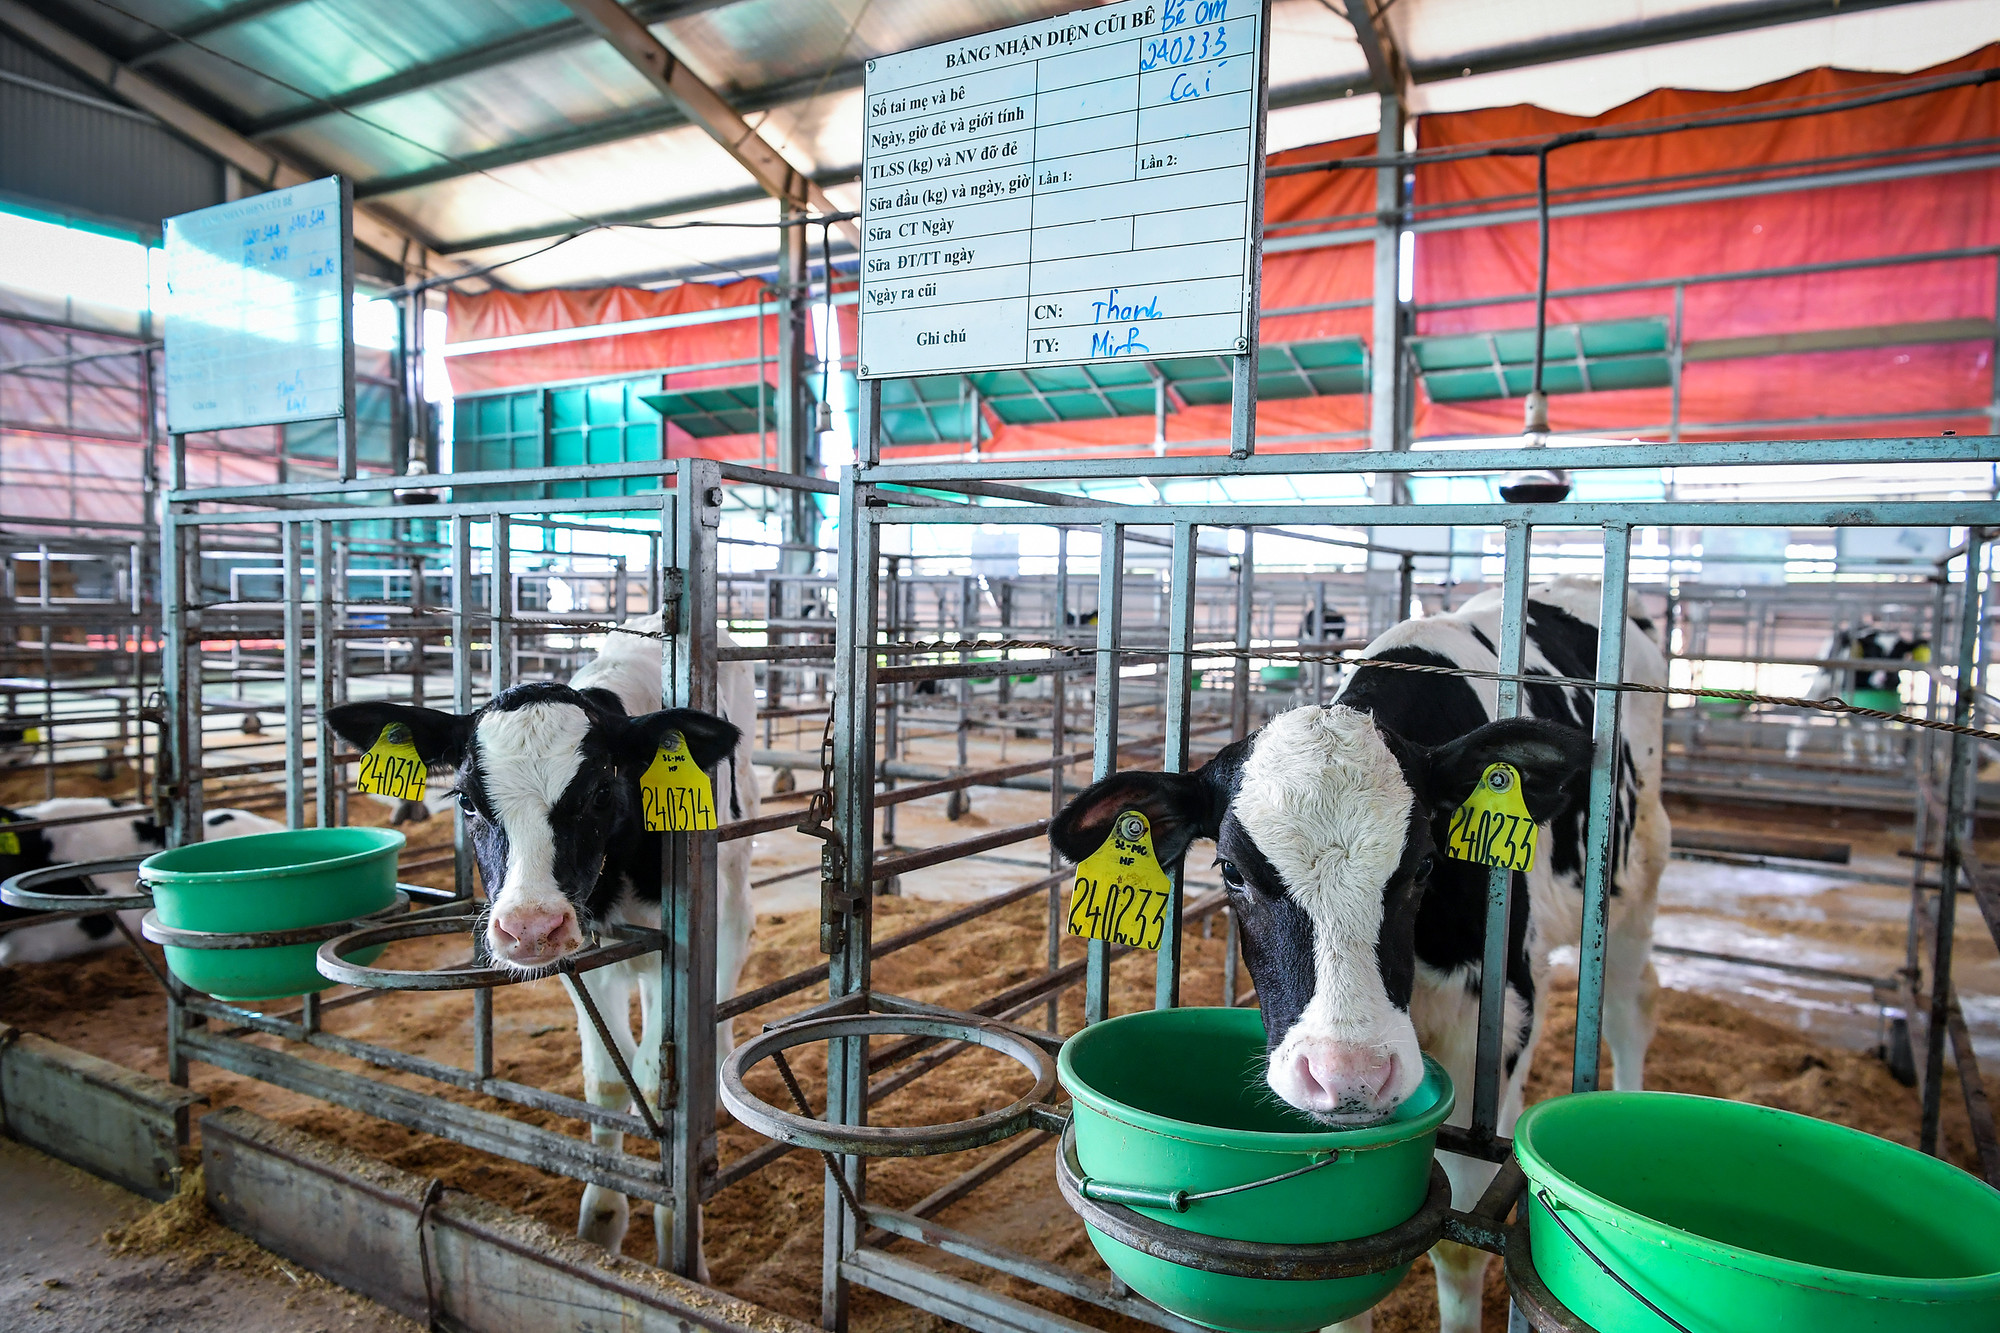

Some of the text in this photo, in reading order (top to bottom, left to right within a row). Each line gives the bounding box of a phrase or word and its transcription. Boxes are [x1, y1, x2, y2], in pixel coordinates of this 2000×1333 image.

[946, 5, 1156, 69] BẢNG NHẬN DIỆN CŨI BÊ
[1141, 26, 1228, 71] 240233
[872, 86, 966, 118] Số tai mẹ và bê
[871, 106, 1024, 149] Ngày, giờ đẻ và giới tính
[871, 141, 1018, 179] TLSS (kg) và NV đỡ đẻ
[1141, 154, 1178, 171] Lần 2:
[869, 174, 1032, 212] Sữa đầu (kg) và ngày, giờ
[1038, 171, 1072, 186] Lần 1:
[868, 218, 955, 242] Sữa CT Ngày
[867, 248, 975, 273] Sữa ĐT/TT ngày
[866, 283, 937, 306] Ngày ra cũi
[1034, 304, 1063, 320] CN:
[916, 328, 967, 346] Ghi chú
[1033, 338, 1059, 354] TY:
[358, 752, 425, 801] 240314
[642, 786, 710, 831] 240314
[1445, 805, 1534, 872] 240233
[1068, 877, 1169, 950] 240233
